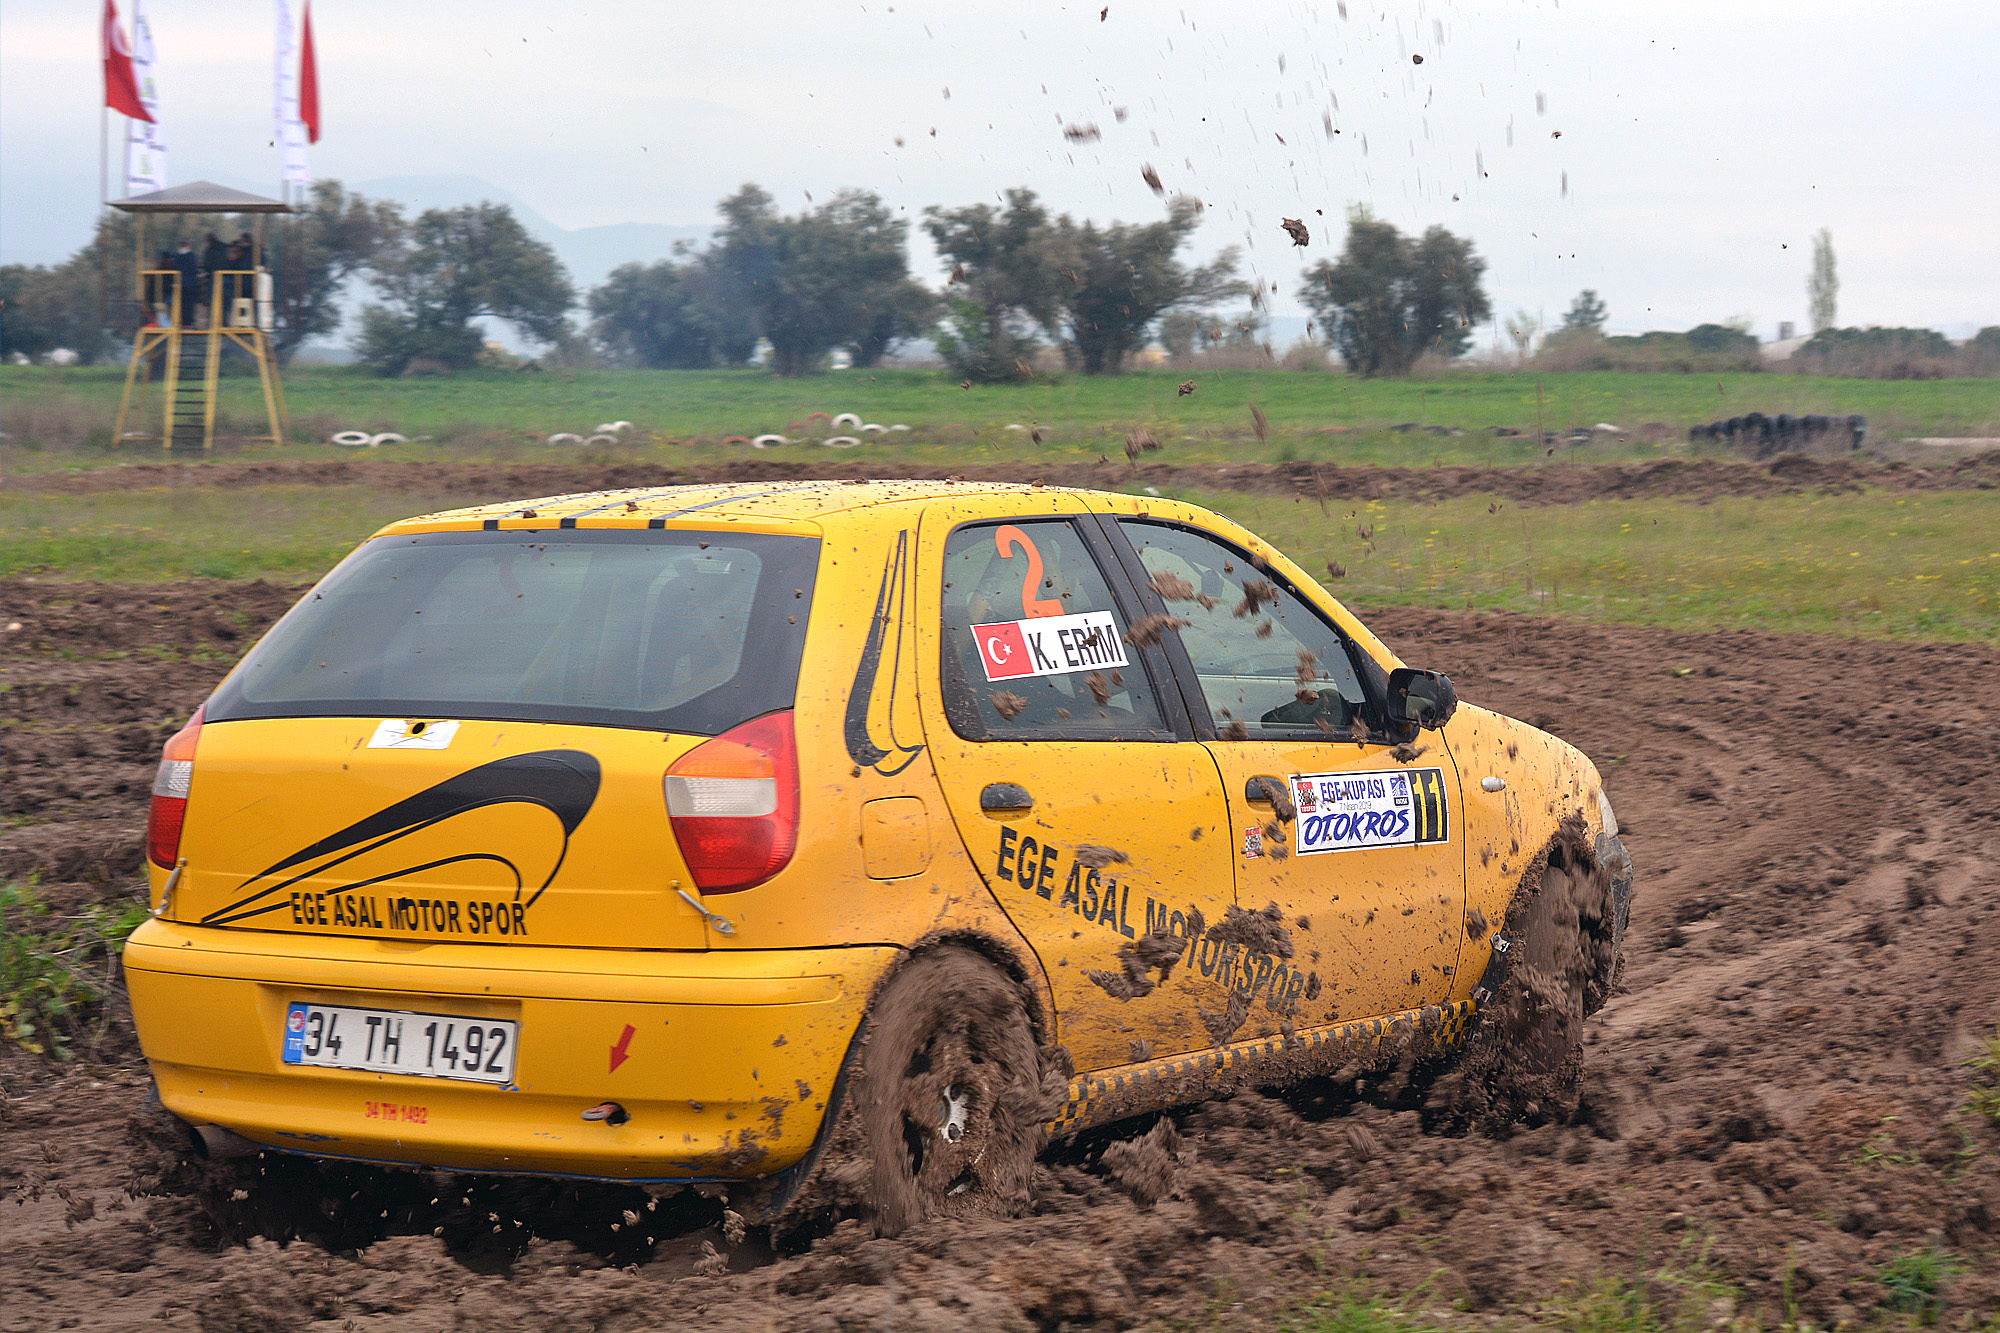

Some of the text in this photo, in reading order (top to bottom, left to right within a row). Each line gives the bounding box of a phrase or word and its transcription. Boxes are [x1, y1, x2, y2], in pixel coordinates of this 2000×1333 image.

[994, 525, 1065, 619] 2
[1028, 618, 1123, 670] K. ERİM
[1320, 779, 1386, 802] EGE KUPASI
[1413, 772, 1443, 839] 11
[1302, 809, 1410, 845] OTOKROS
[291, 892, 527, 935] EGE ASAL MOTOR SPOR
[997, 825, 1058, 900] EGE
[1061, 860, 1134, 940] ASAL
[1237, 949, 1304, 1016] SPOR
[288, 1012, 506, 1073] TR 34 TH 1492
[365, 1101, 428, 1125] 34 TH 1492
